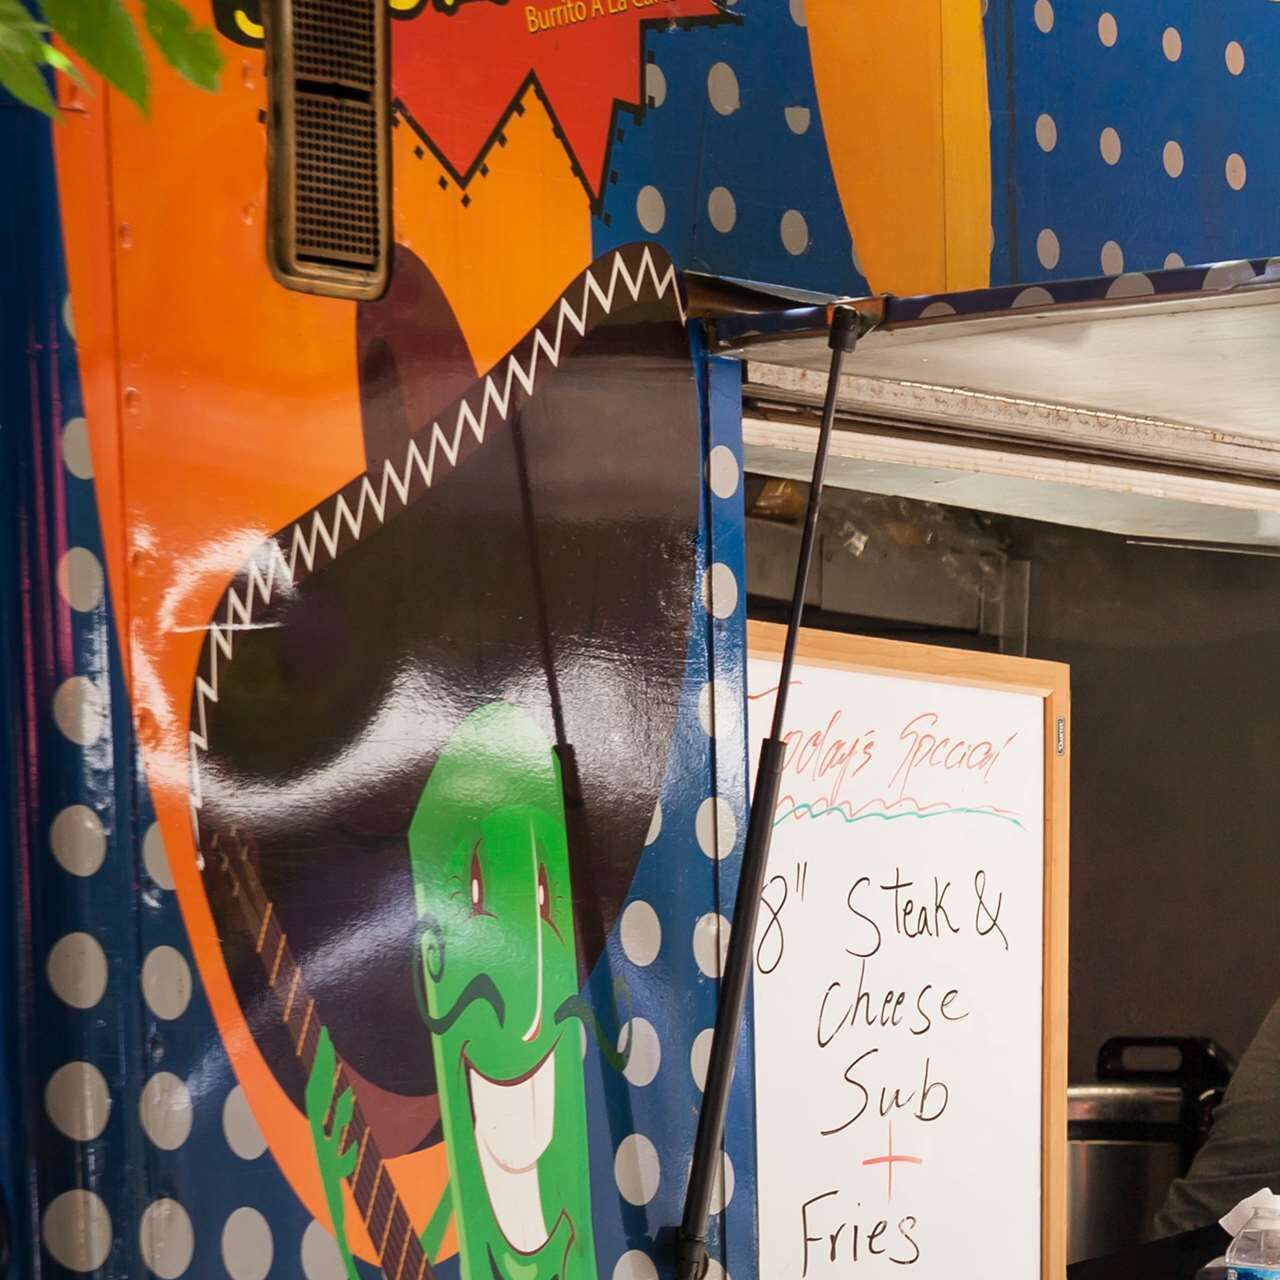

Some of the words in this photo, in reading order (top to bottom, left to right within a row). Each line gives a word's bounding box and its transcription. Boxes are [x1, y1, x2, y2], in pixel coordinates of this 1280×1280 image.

[524, 0, 587, 32] Burrito
[846, 868, 960, 958] Steak
[975, 870, 1009, 951] &
[821, 1048, 950, 1136] Sub
[802, 1189, 921, 1279] Fries
